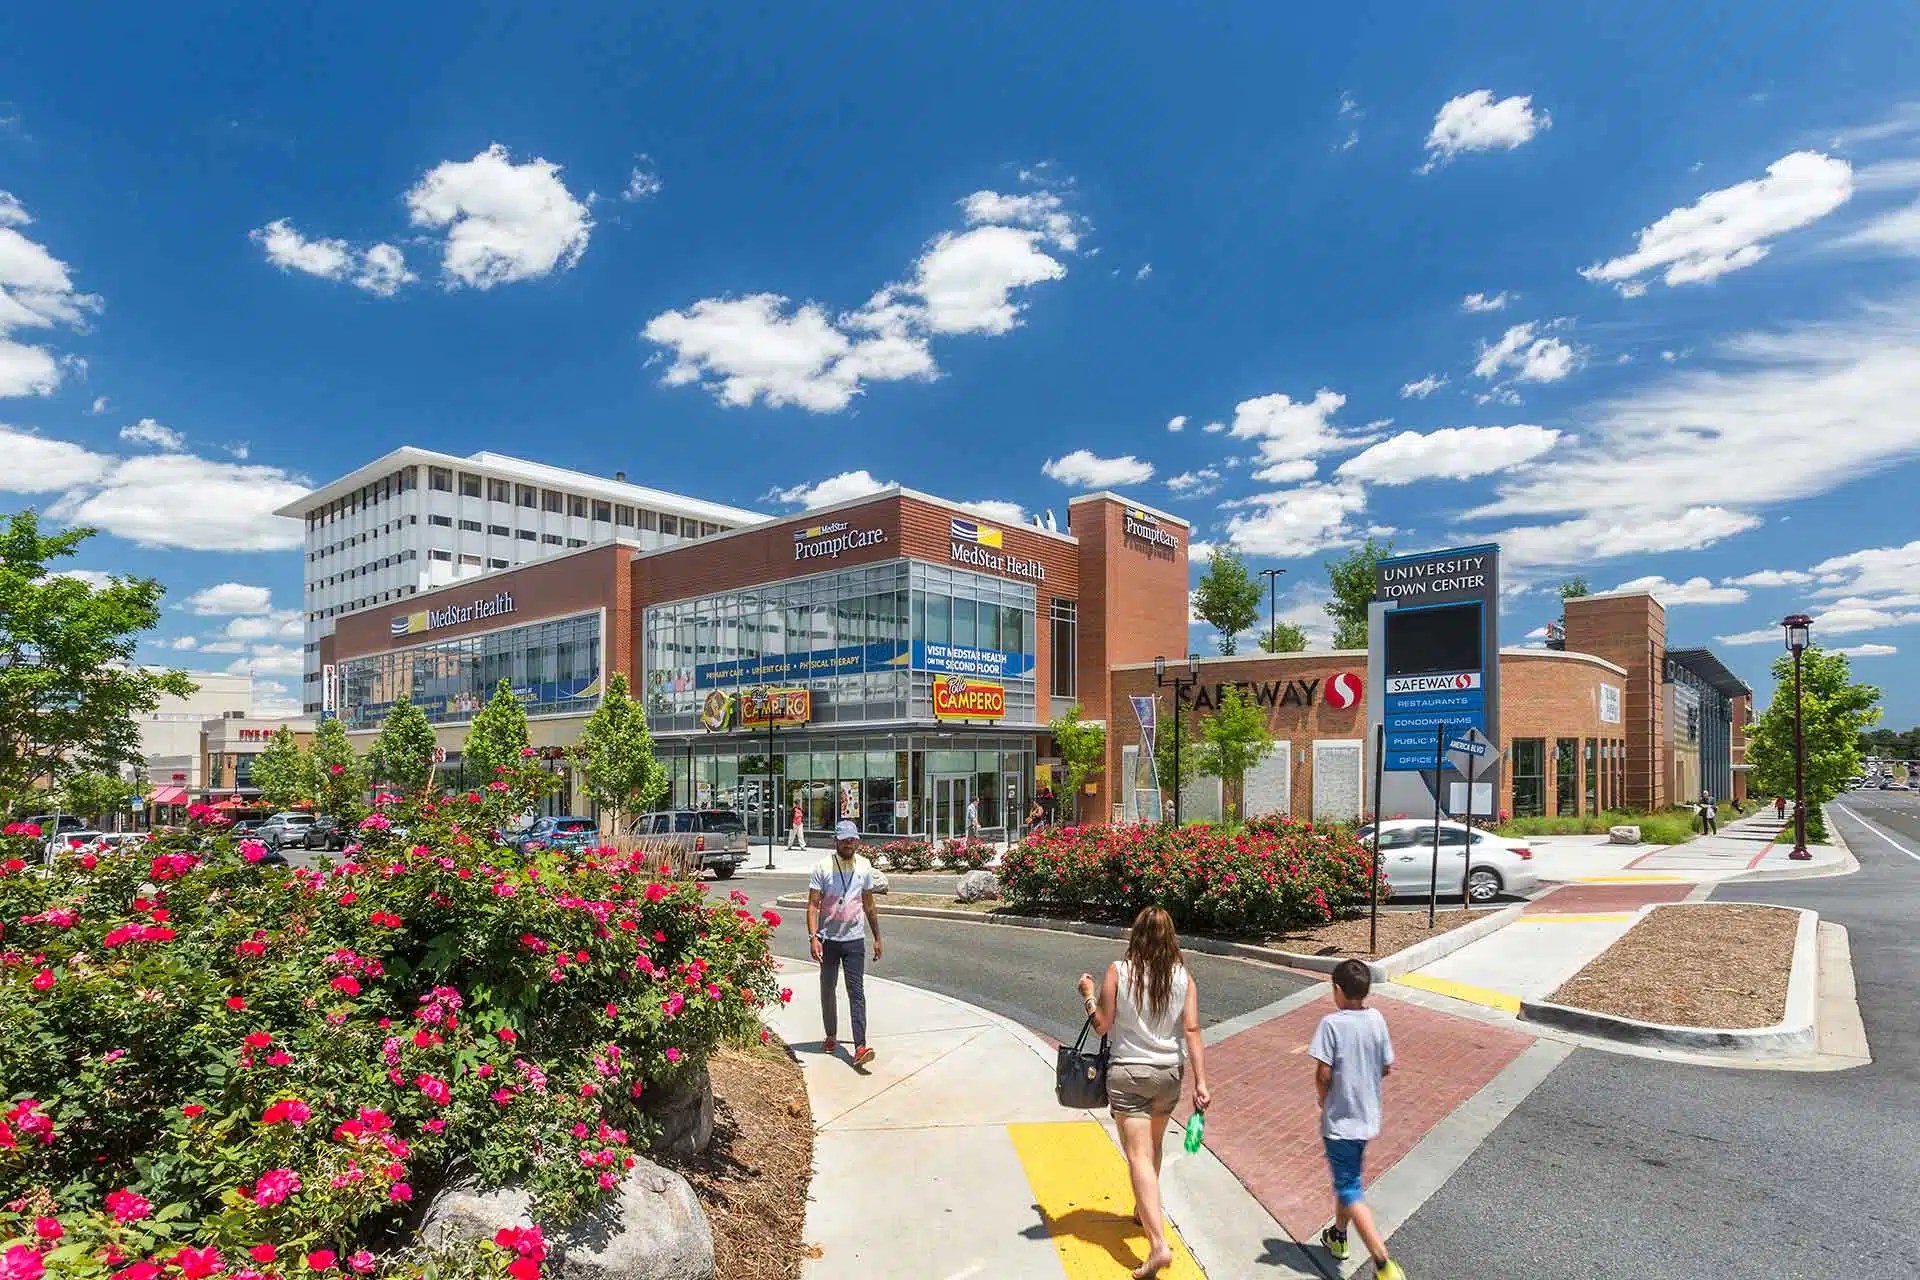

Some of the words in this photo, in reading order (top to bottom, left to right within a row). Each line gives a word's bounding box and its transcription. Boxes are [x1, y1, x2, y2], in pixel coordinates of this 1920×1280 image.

[951, 542, 1005, 570] MedStar
[1006, 555, 1045, 579] Health
[1384, 557, 1484, 581] UNIVERSITY
[1384, 582, 1426, 598] TOWN
[1432, 575, 1485, 592] CENTER
[430, 604, 474, 629] MedStar
[474, 592, 514, 620] Health
[927, 646, 946, 657] VISIT
[981, 652, 1007, 663] HEALTH
[945, 660, 976, 672] SECOND
[977, 663, 1000, 674] FLOOR
[1394, 676, 1455, 692] SAFEWAY
[743, 698, 805, 718] CAMPRO
[938, 690, 1002, 711] CAMPERO
[1397, 697, 1468, 707] RESTAURANTS
[1393, 737, 1427, 745] PUBLIC
[1470, 744, 1484, 754] BLVD
